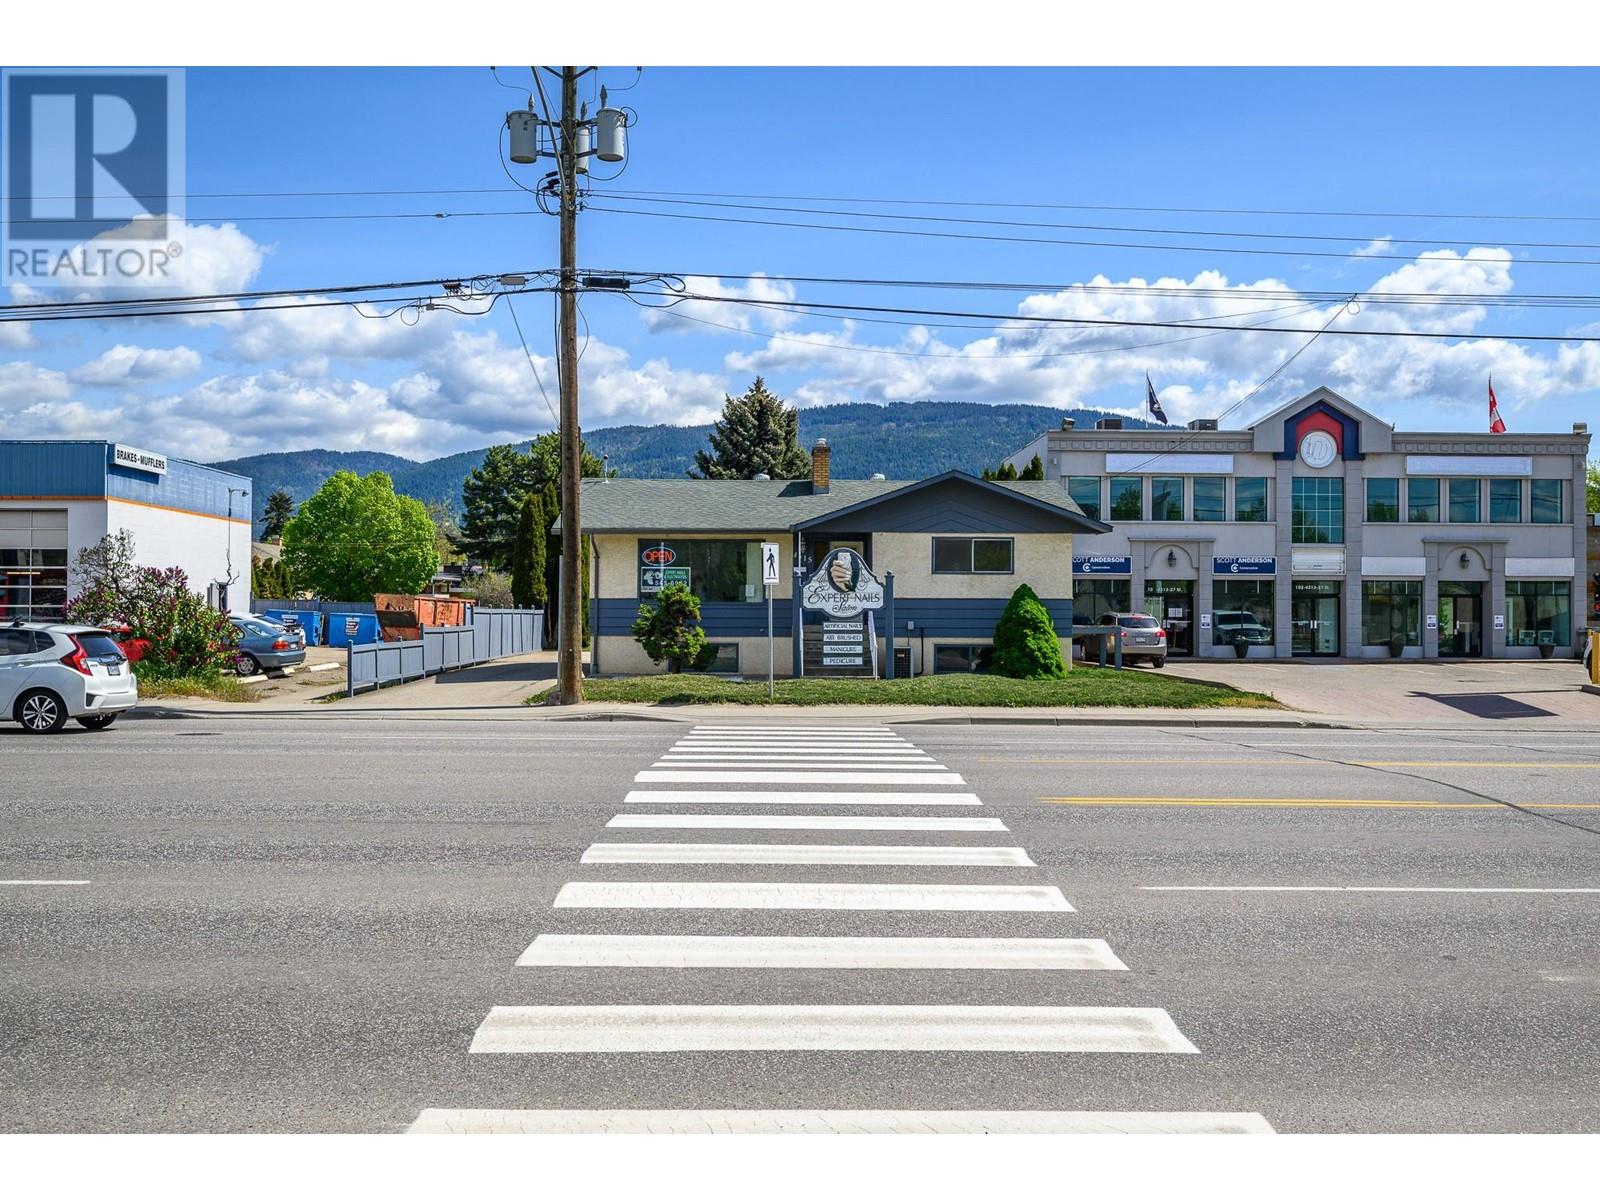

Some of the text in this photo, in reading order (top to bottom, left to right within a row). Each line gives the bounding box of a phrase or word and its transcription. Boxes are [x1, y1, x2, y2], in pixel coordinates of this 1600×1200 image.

[645, 550, 673, 562] OPEN
[807, 585, 880, 604] EXPERT NAILS
